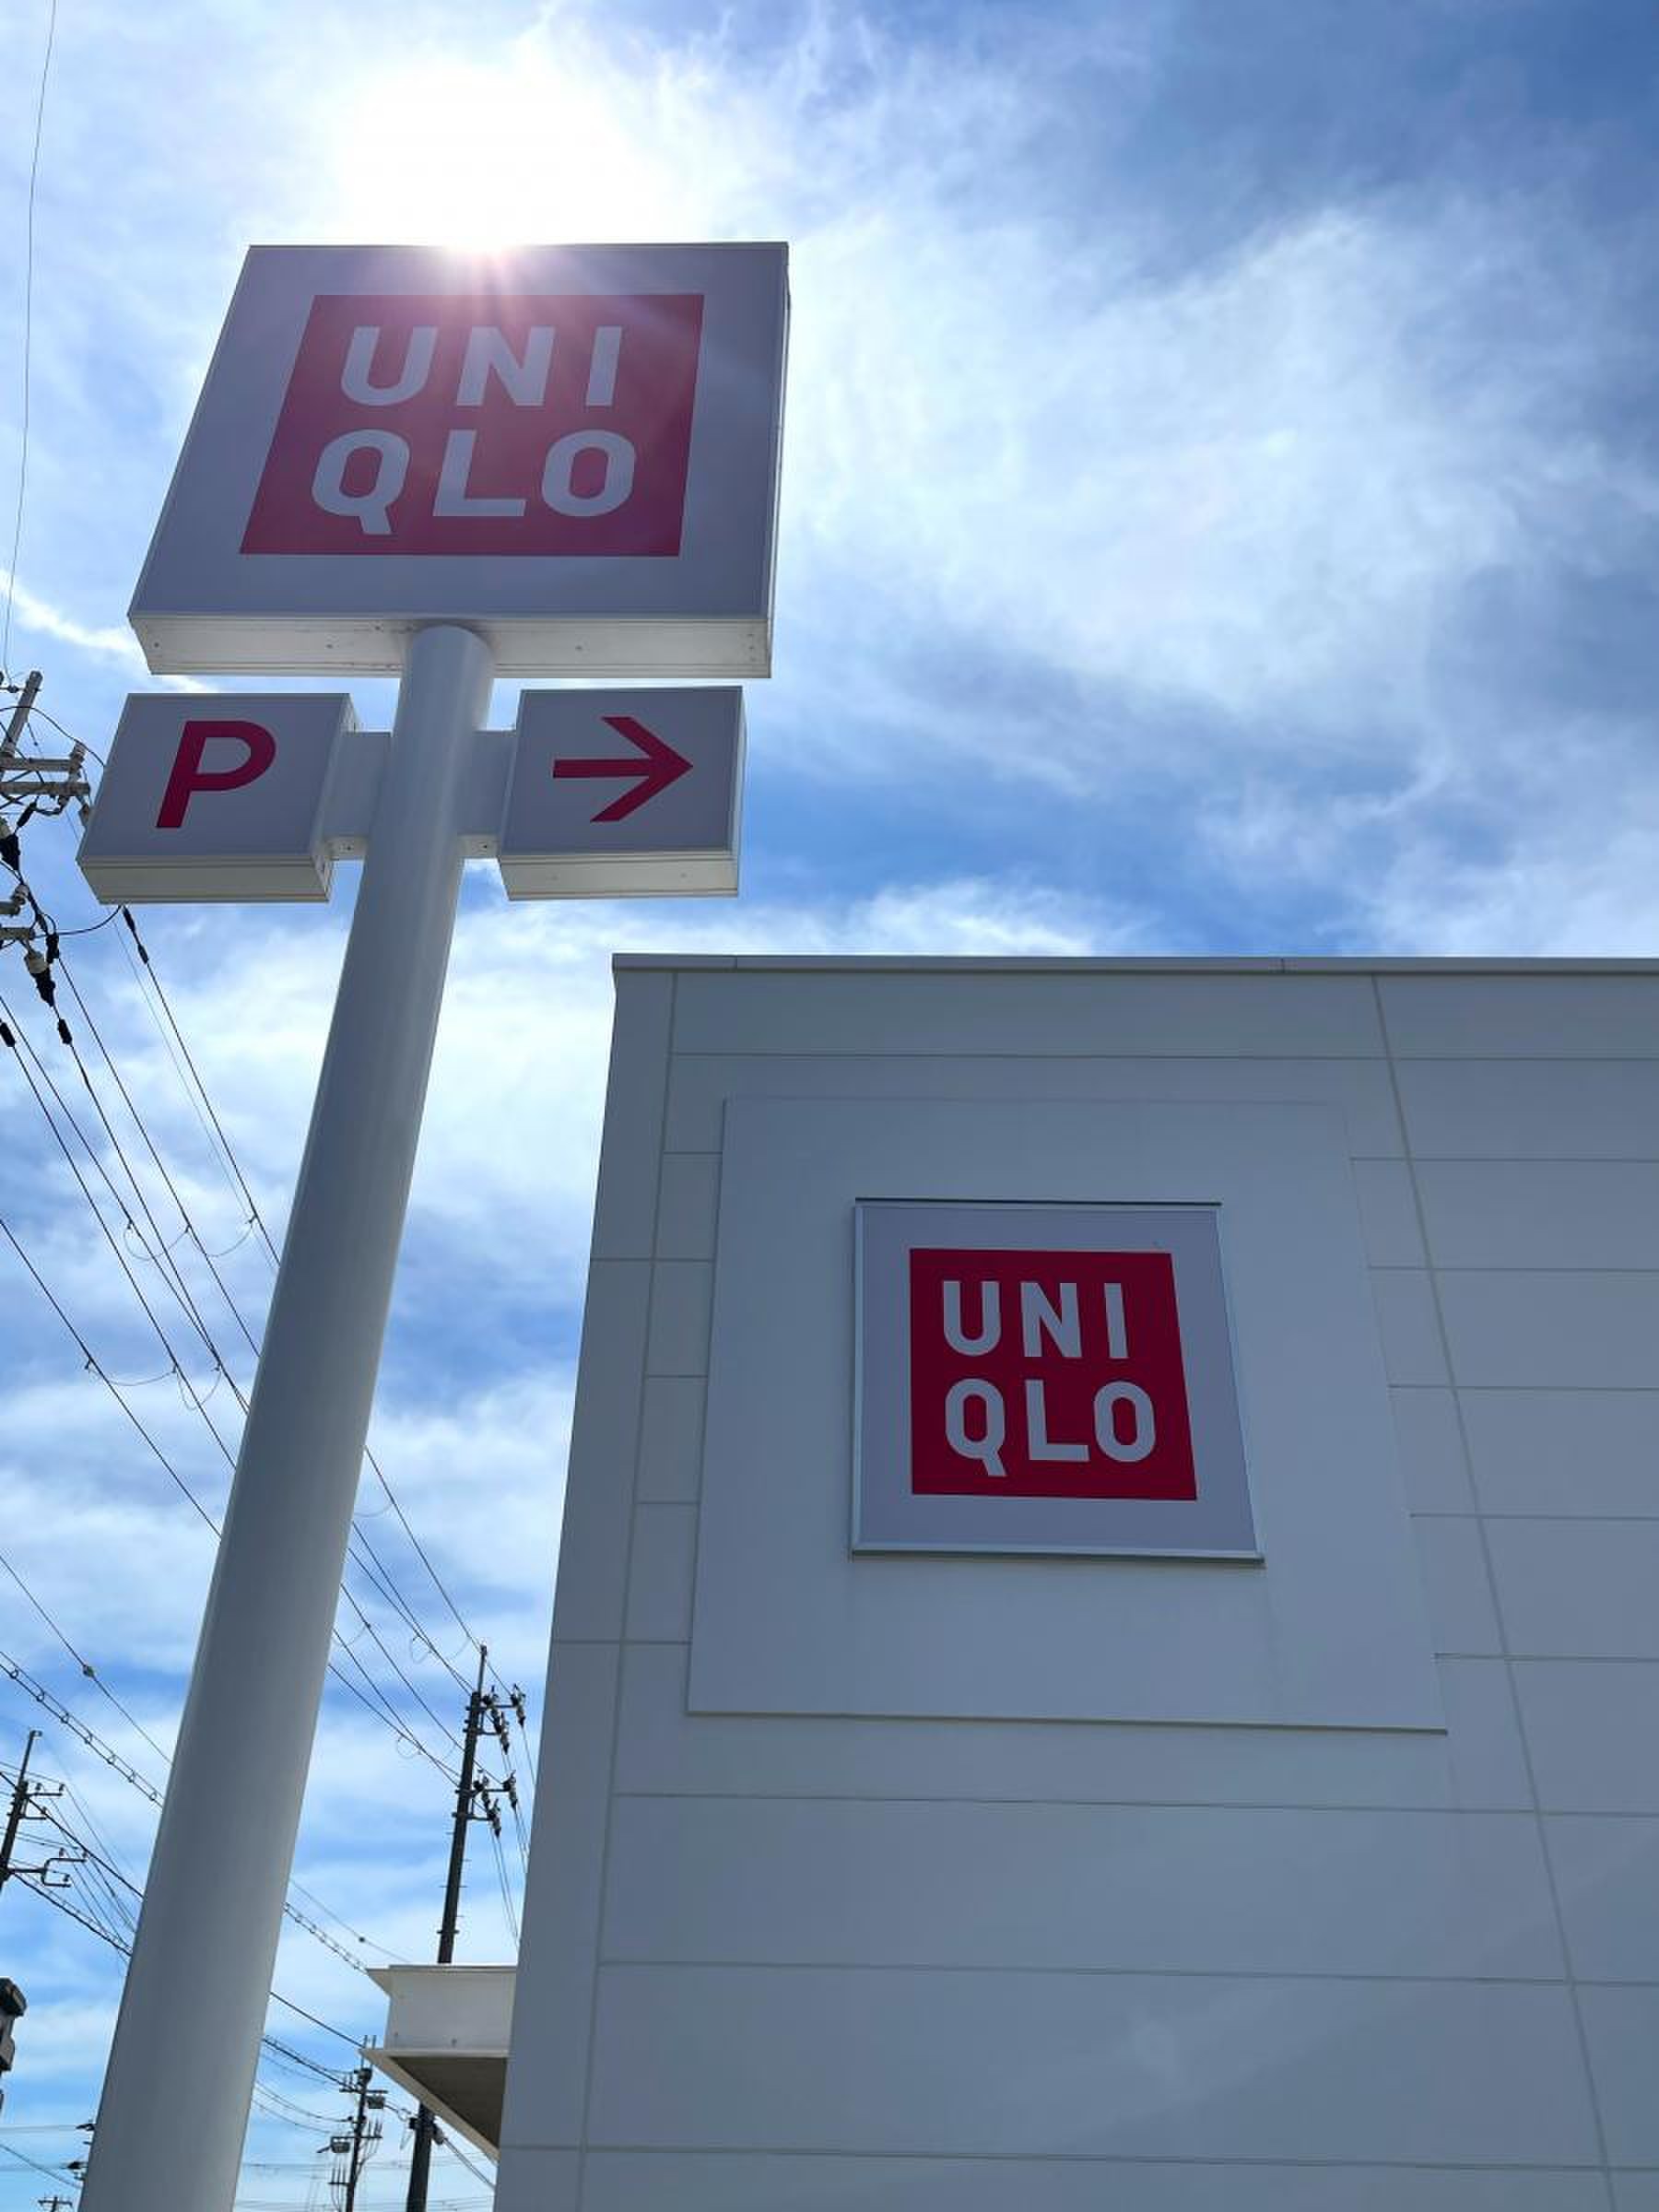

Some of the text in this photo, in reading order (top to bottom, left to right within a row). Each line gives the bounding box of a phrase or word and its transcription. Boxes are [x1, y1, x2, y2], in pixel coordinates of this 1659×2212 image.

[340, 325, 624, 407] UNI
[310, 429, 638, 535] QLO
[155, 720, 276, 829] P
[942, 1280, 1130, 1359] UNI
[945, 1377, 1157, 1477] QLO
